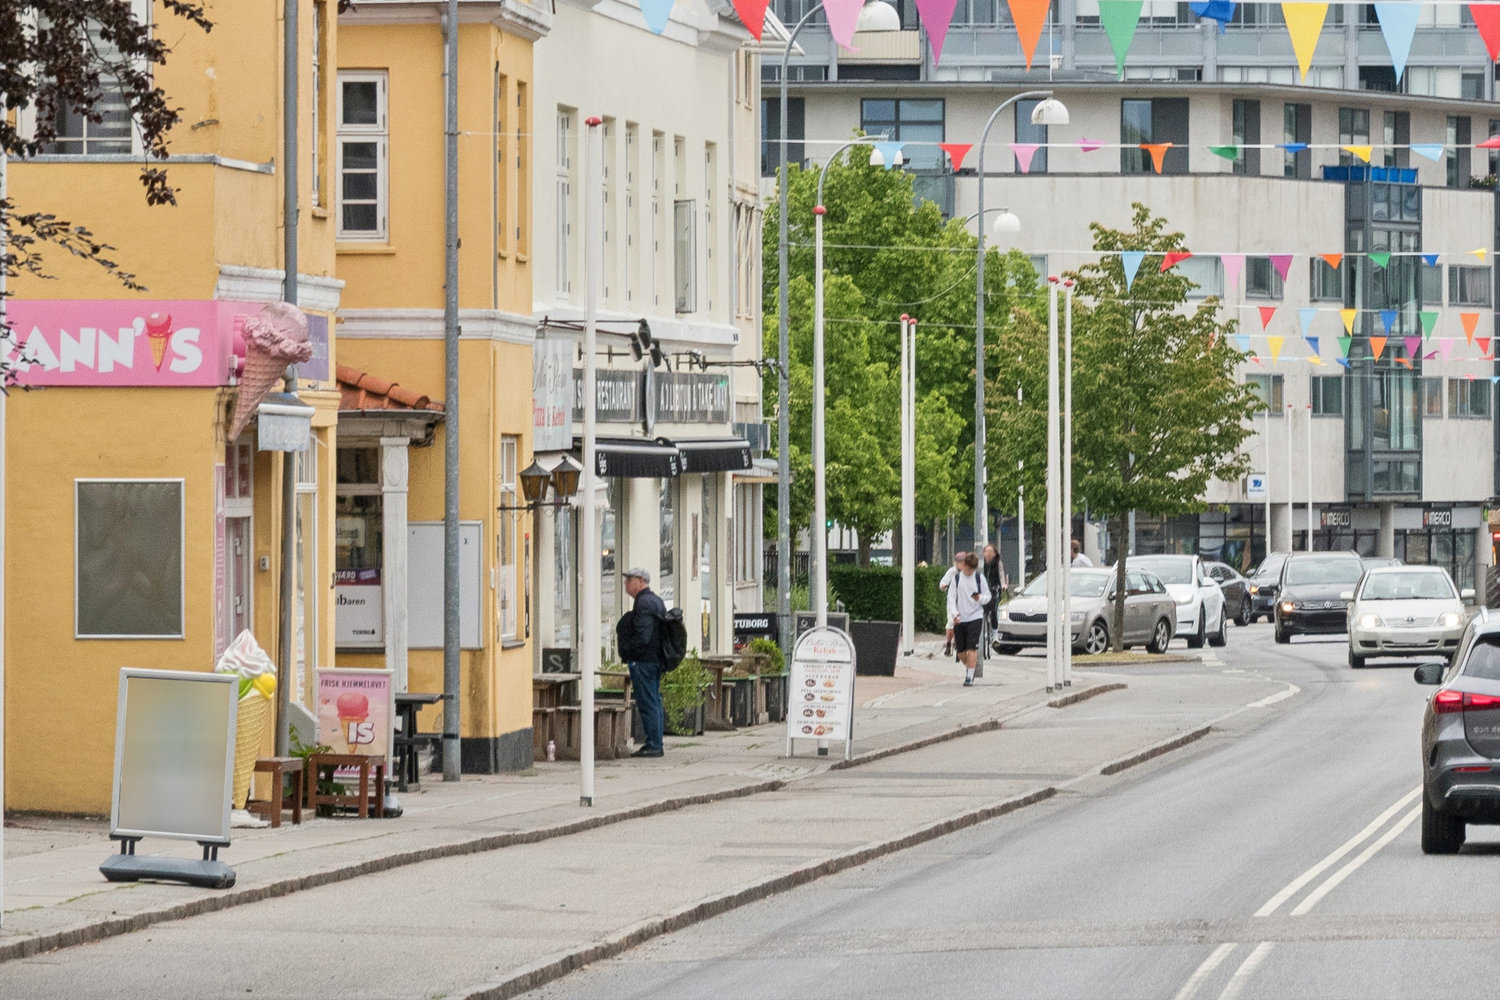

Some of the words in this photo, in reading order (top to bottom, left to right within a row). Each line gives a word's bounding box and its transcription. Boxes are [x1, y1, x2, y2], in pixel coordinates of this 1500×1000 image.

[597, 380, 636, 410] RESTAURANT
[733, 618, 769, 629] TUBORG
[320, 679, 340, 688] FRISK
[347, 721, 375, 745] IS
